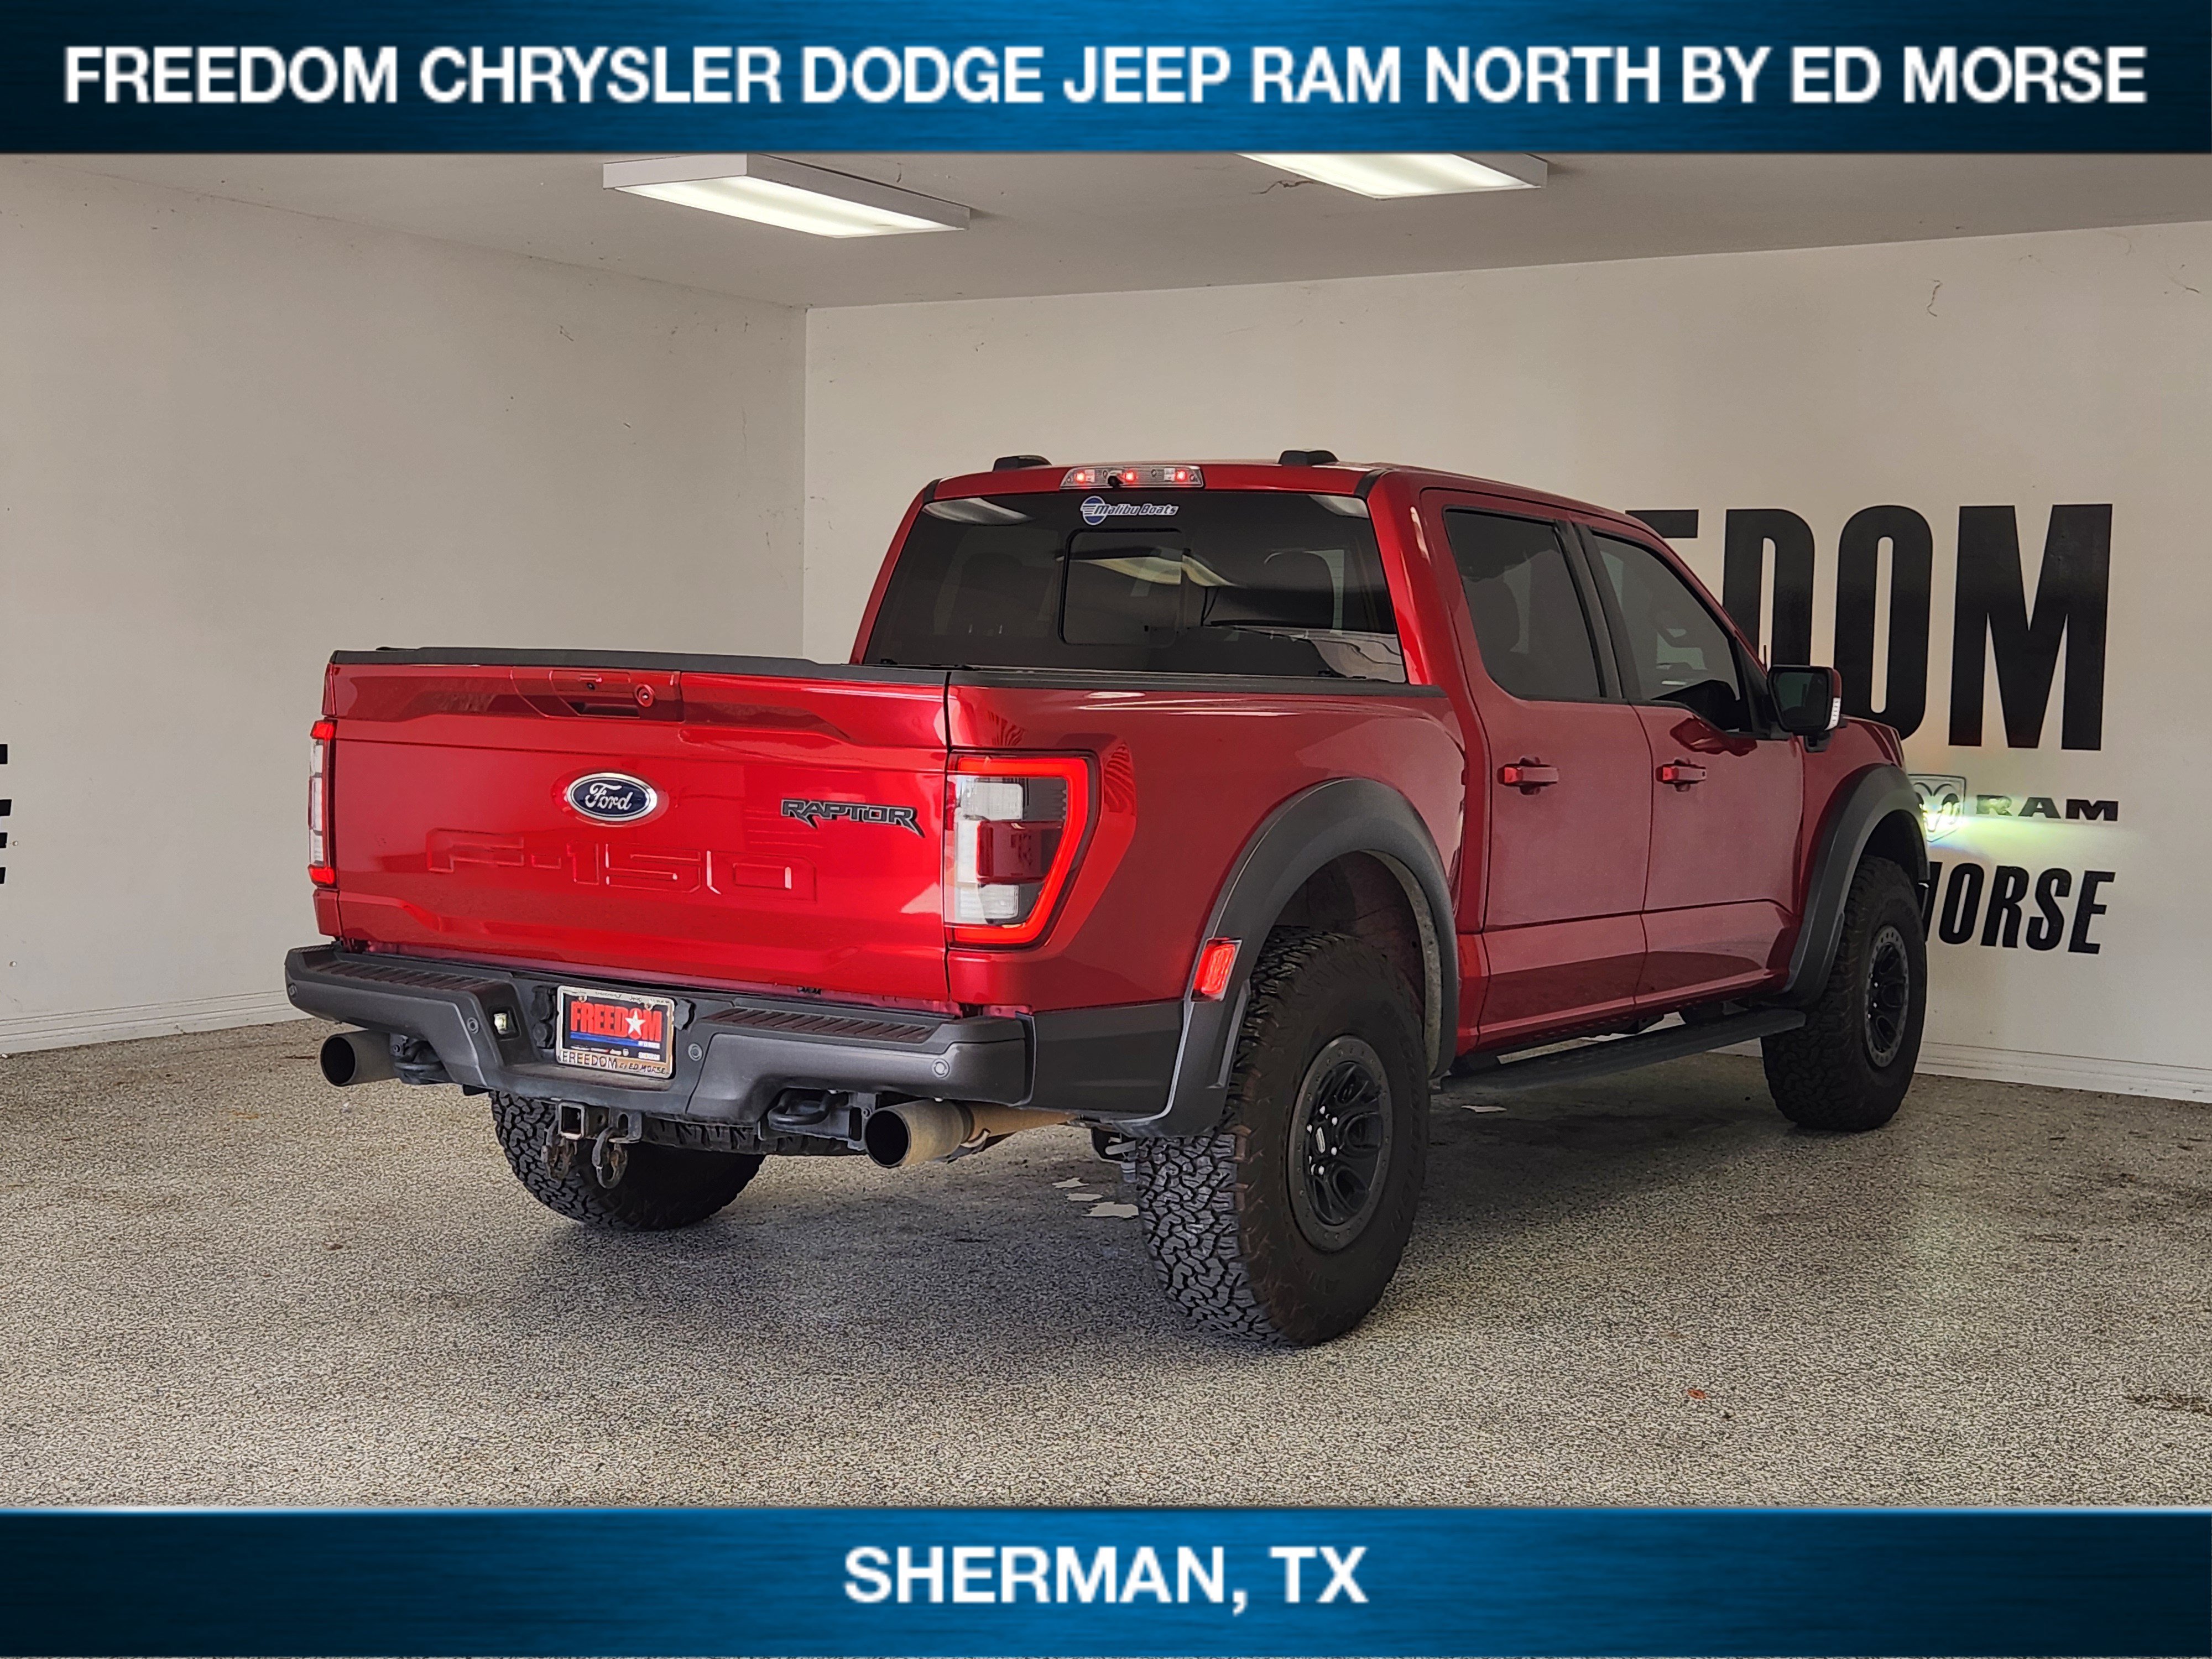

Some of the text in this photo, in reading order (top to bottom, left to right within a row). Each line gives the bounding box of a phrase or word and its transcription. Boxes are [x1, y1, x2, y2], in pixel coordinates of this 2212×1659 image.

[1094, 503, 1178, 515] Malibu Boats
[1625, 504, 2112, 750] DOM
[585, 783, 633, 811] Ford
[1976, 795, 2118, 821] RAM
[781, 798, 925, 838] RAPTOR
[426, 828, 816, 902] F-150
[571, 1001, 662, 1041] FREEDOM
[562, 1051, 617, 1069] FREEDOM
